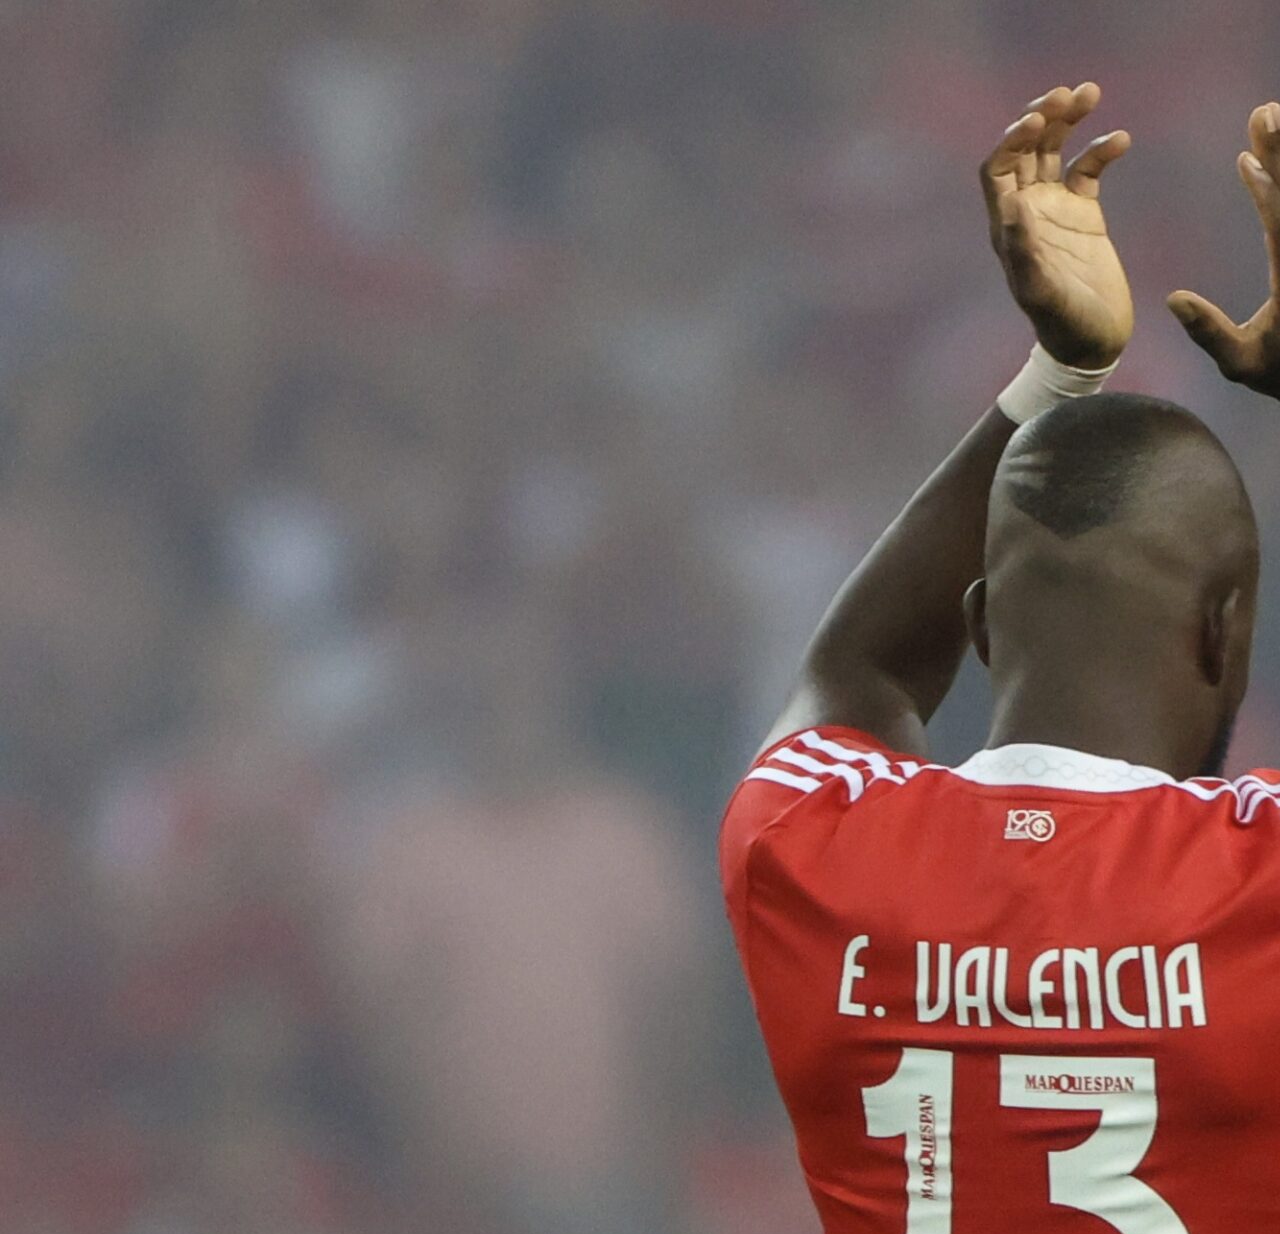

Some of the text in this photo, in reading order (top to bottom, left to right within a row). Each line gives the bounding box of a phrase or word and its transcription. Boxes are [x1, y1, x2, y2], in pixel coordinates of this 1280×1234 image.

[838, 934, 1206, 1029] E. VALENCIA
[1024, 1073, 1136, 1095] MARQUESPAN
[919, 1093, 938, 1200] MARQUESPAN
